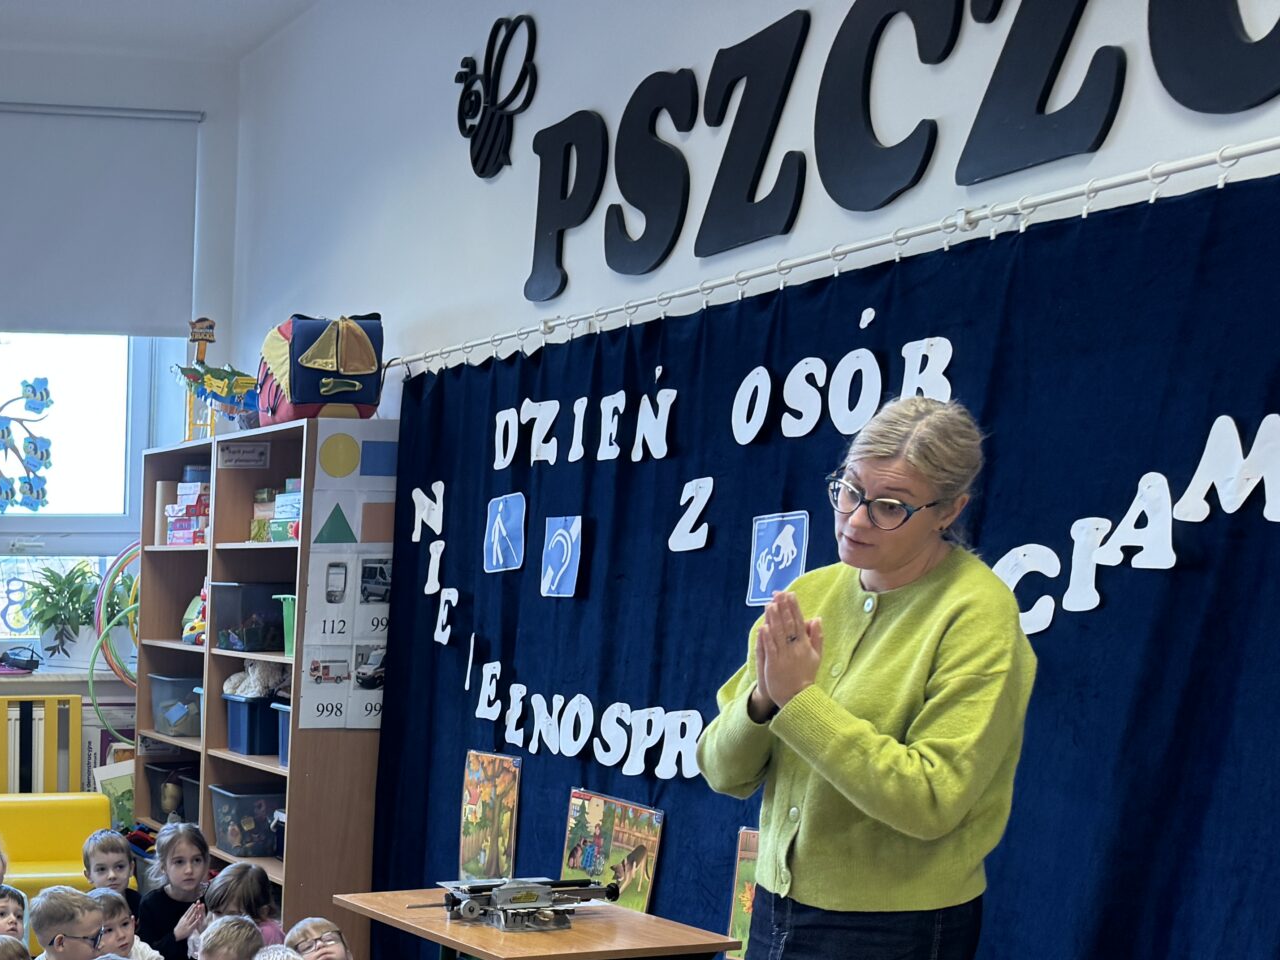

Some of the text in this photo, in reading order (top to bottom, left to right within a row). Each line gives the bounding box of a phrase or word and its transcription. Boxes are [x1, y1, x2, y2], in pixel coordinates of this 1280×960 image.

[493, 307, 953, 471] DZIEŃ OSÓB
[668, 476, 714, 552] Z
[321, 619, 347, 635] 112
[371, 617, 389, 632] 99
[316, 702, 344, 718] 998
[364, 702, 382, 717] 99
